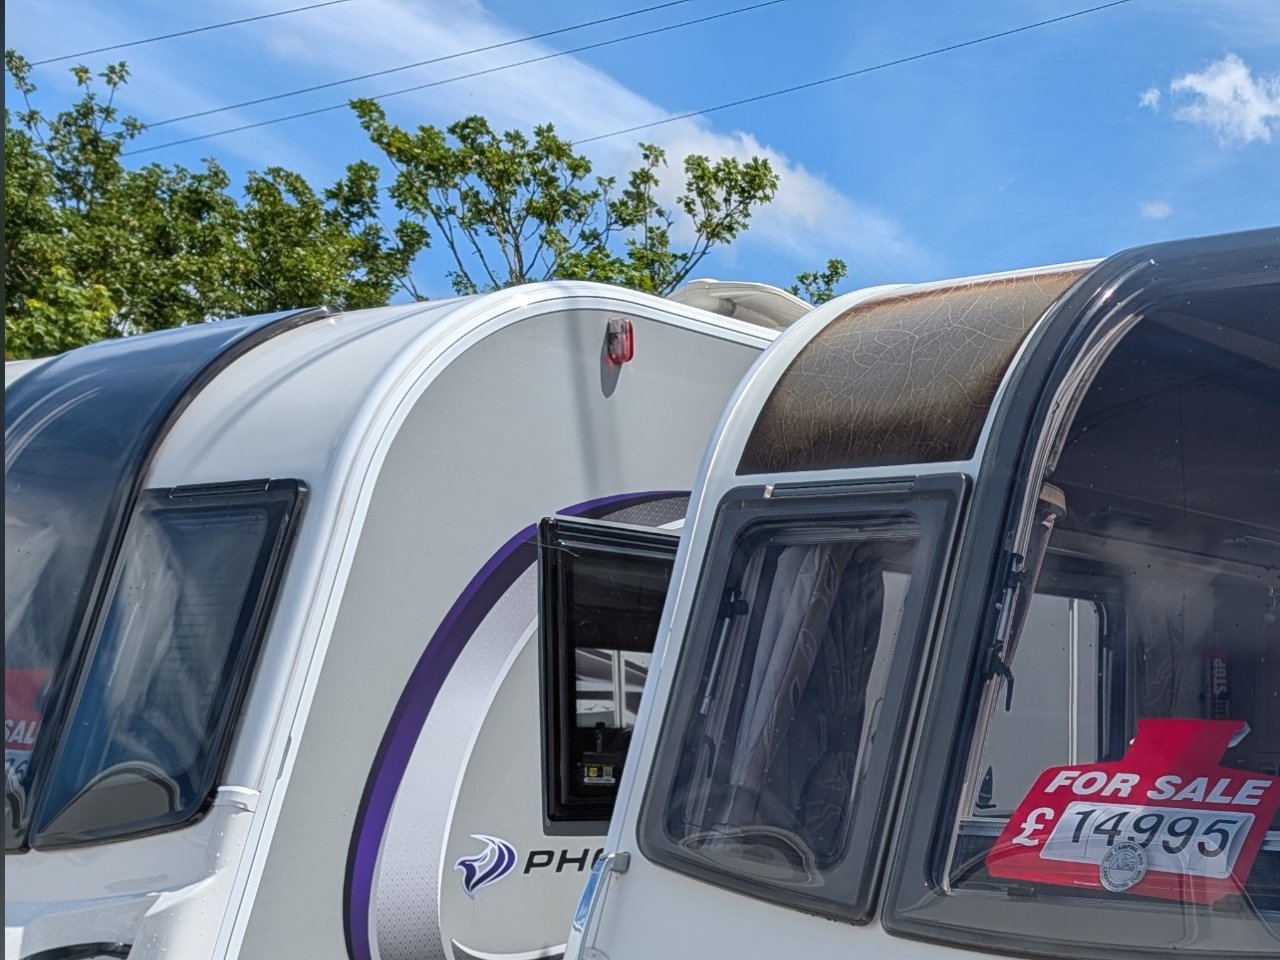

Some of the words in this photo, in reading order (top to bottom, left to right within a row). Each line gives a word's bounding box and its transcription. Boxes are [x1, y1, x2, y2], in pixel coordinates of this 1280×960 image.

[1213, 658, 1228, 695] STOP
[1044, 769, 1141, 798] FOR
[1146, 774, 1273, 806] SALE
[1012, 807, 1055, 847] £
[1071, 808, 1241, 858] 14995
